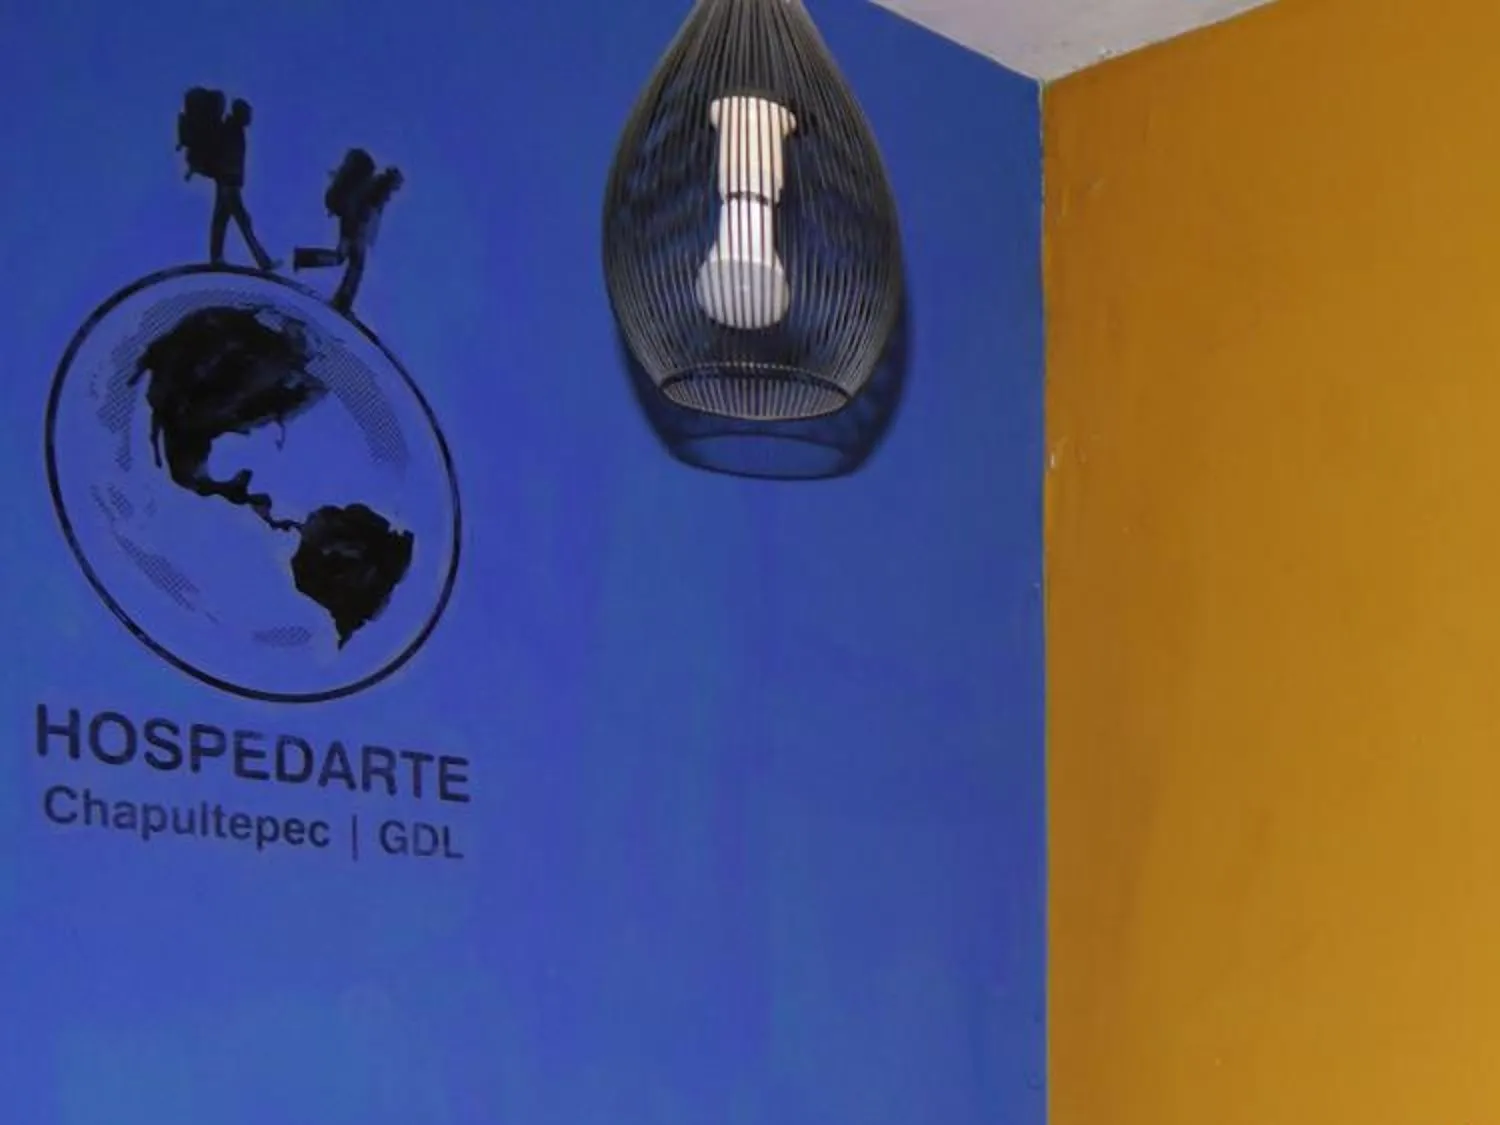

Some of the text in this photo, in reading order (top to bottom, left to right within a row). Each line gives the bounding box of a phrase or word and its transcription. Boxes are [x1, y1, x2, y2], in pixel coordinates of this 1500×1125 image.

[36, 703, 471, 804] HOSPEDARTE
[44, 785, 331, 852] Chapultepec
[379, 819, 465, 860] GDL
